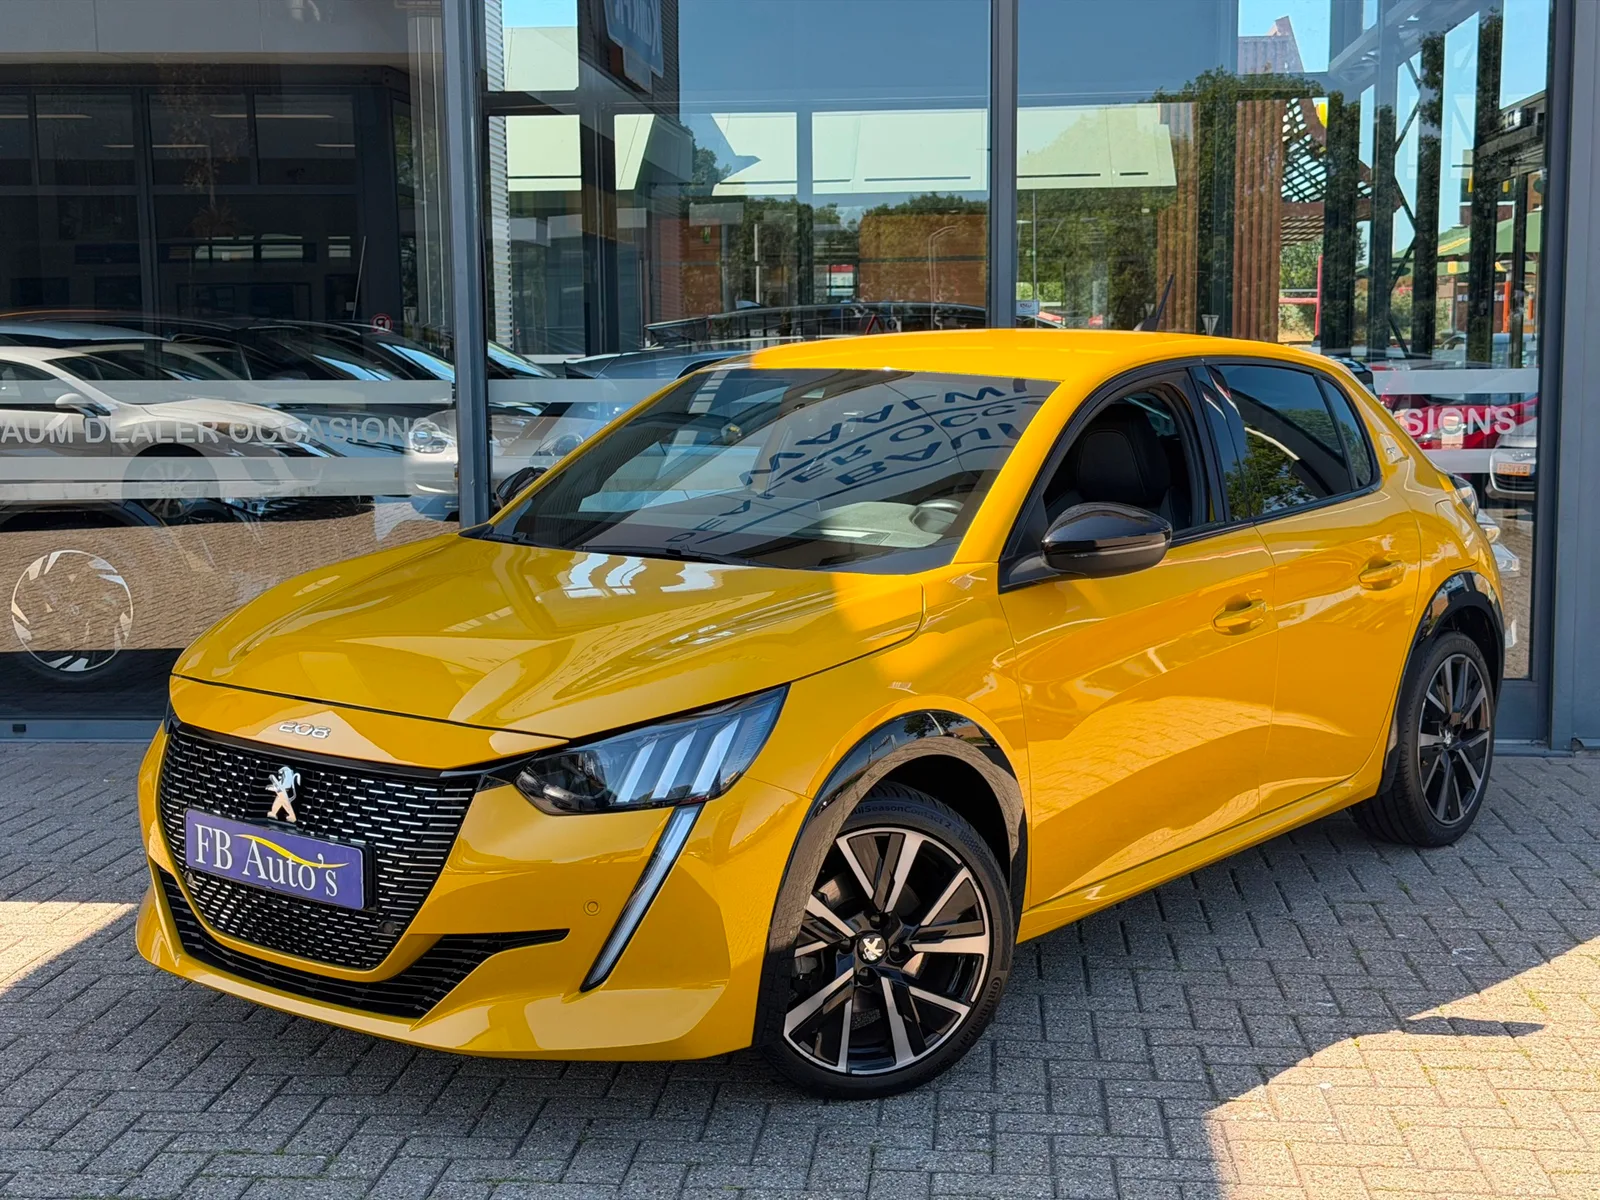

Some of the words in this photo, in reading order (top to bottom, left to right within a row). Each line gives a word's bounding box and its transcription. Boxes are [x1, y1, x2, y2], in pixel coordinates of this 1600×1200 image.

[1, 418, 74, 444] AUM
[85, 417, 219, 444] DEALER
[229, 416, 433, 444] OCCASIONS
[1403, 407, 1516, 436] SIONS
[279, 721, 331, 739] 208
[194, 823, 233, 870] FB
[242, 839, 338, 897] Auto's
